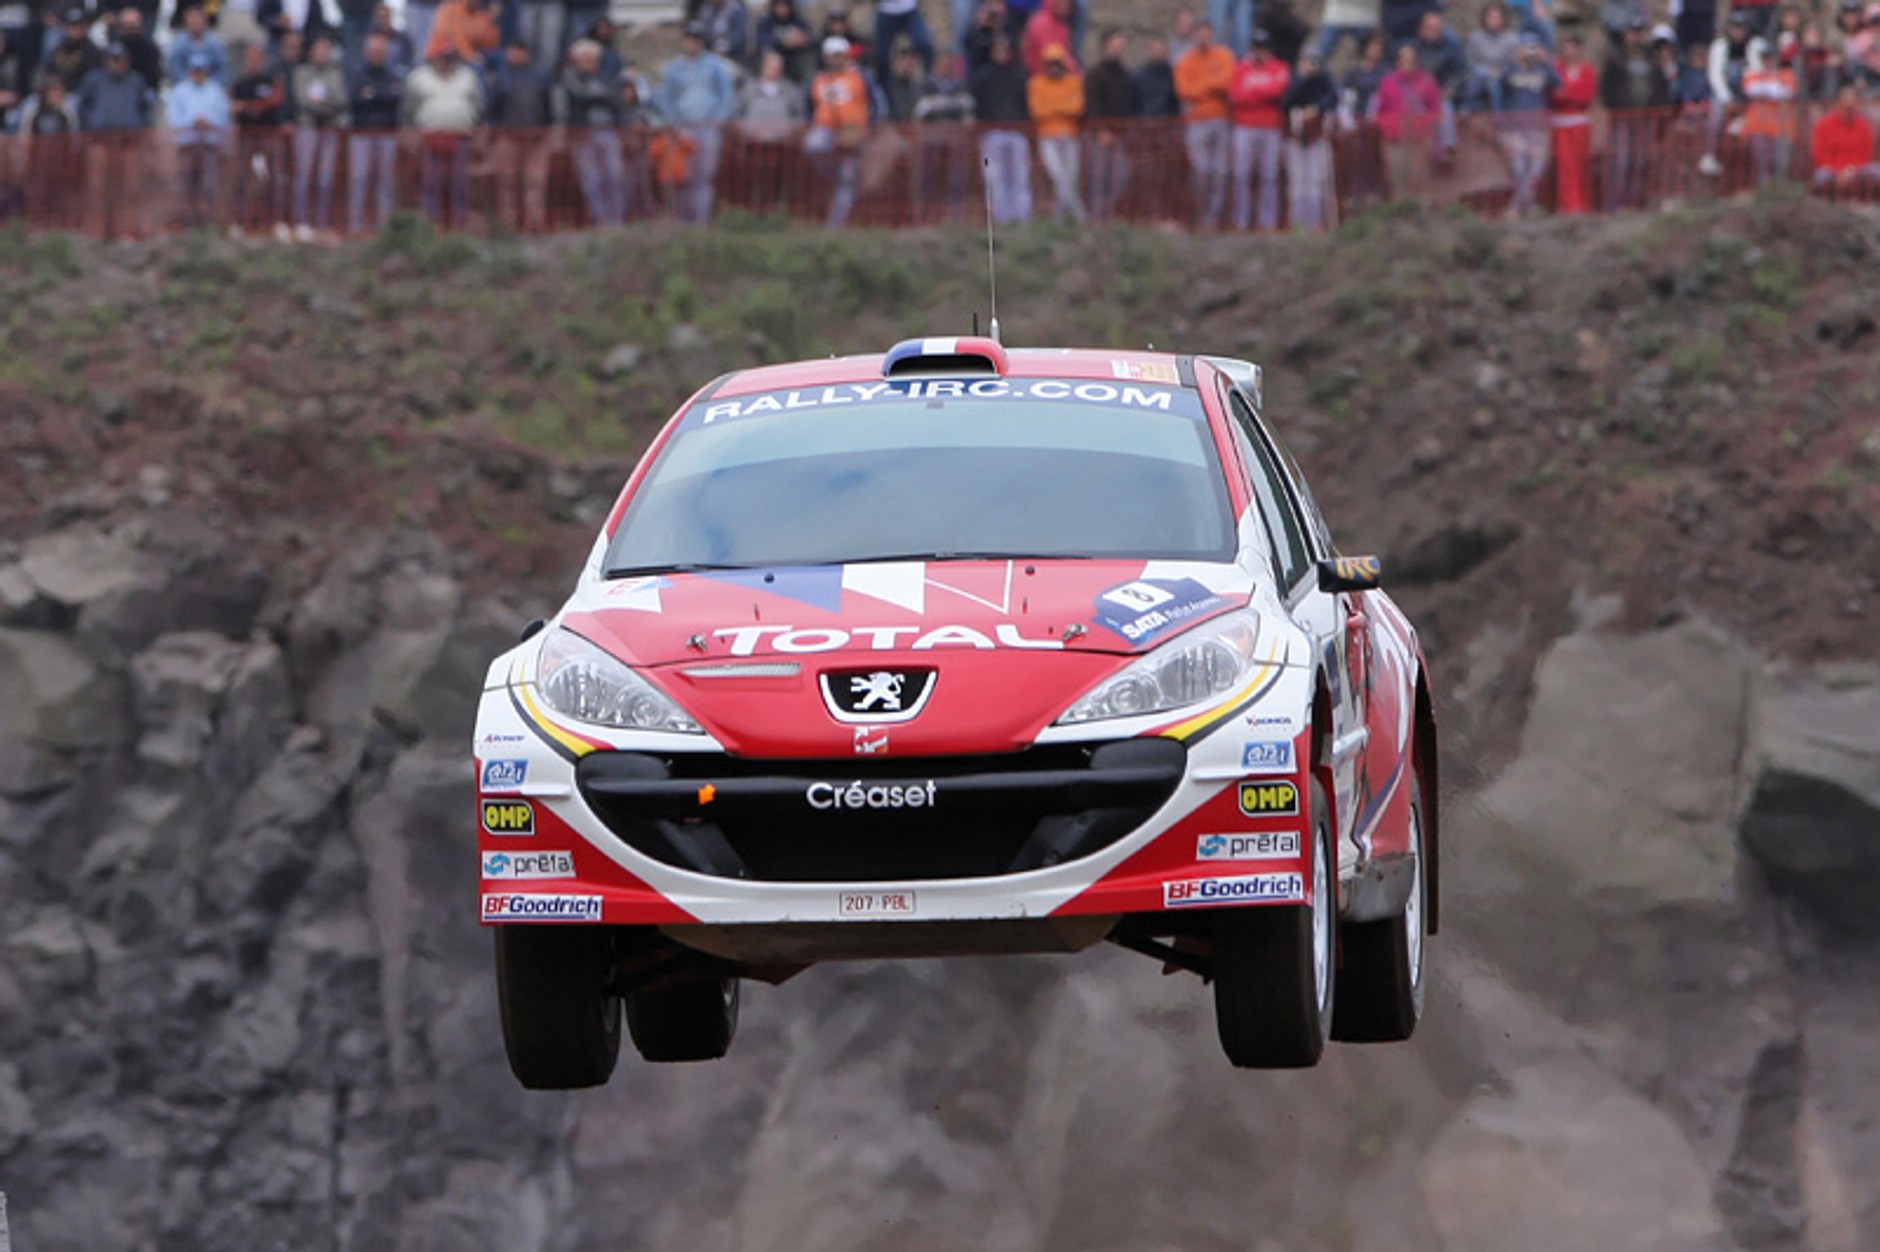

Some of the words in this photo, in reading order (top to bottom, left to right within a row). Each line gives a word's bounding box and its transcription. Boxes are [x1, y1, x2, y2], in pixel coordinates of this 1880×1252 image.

[703, 380, 1172, 425] RALLY-IRC.COM
[1336, 556, 1380, 581] IRC
[1121, 611, 1170, 639] SATA
[713, 625, 1065, 656] TOTAL
[806, 779, 937, 809] Créaset
[1242, 786, 1295, 810] OMP
[485, 805, 531, 829] OMP
[1168, 876, 1301, 900] BFGoodrich
[484, 895, 599, 915] BFGoodrich
[845, 896, 873, 911] 207
